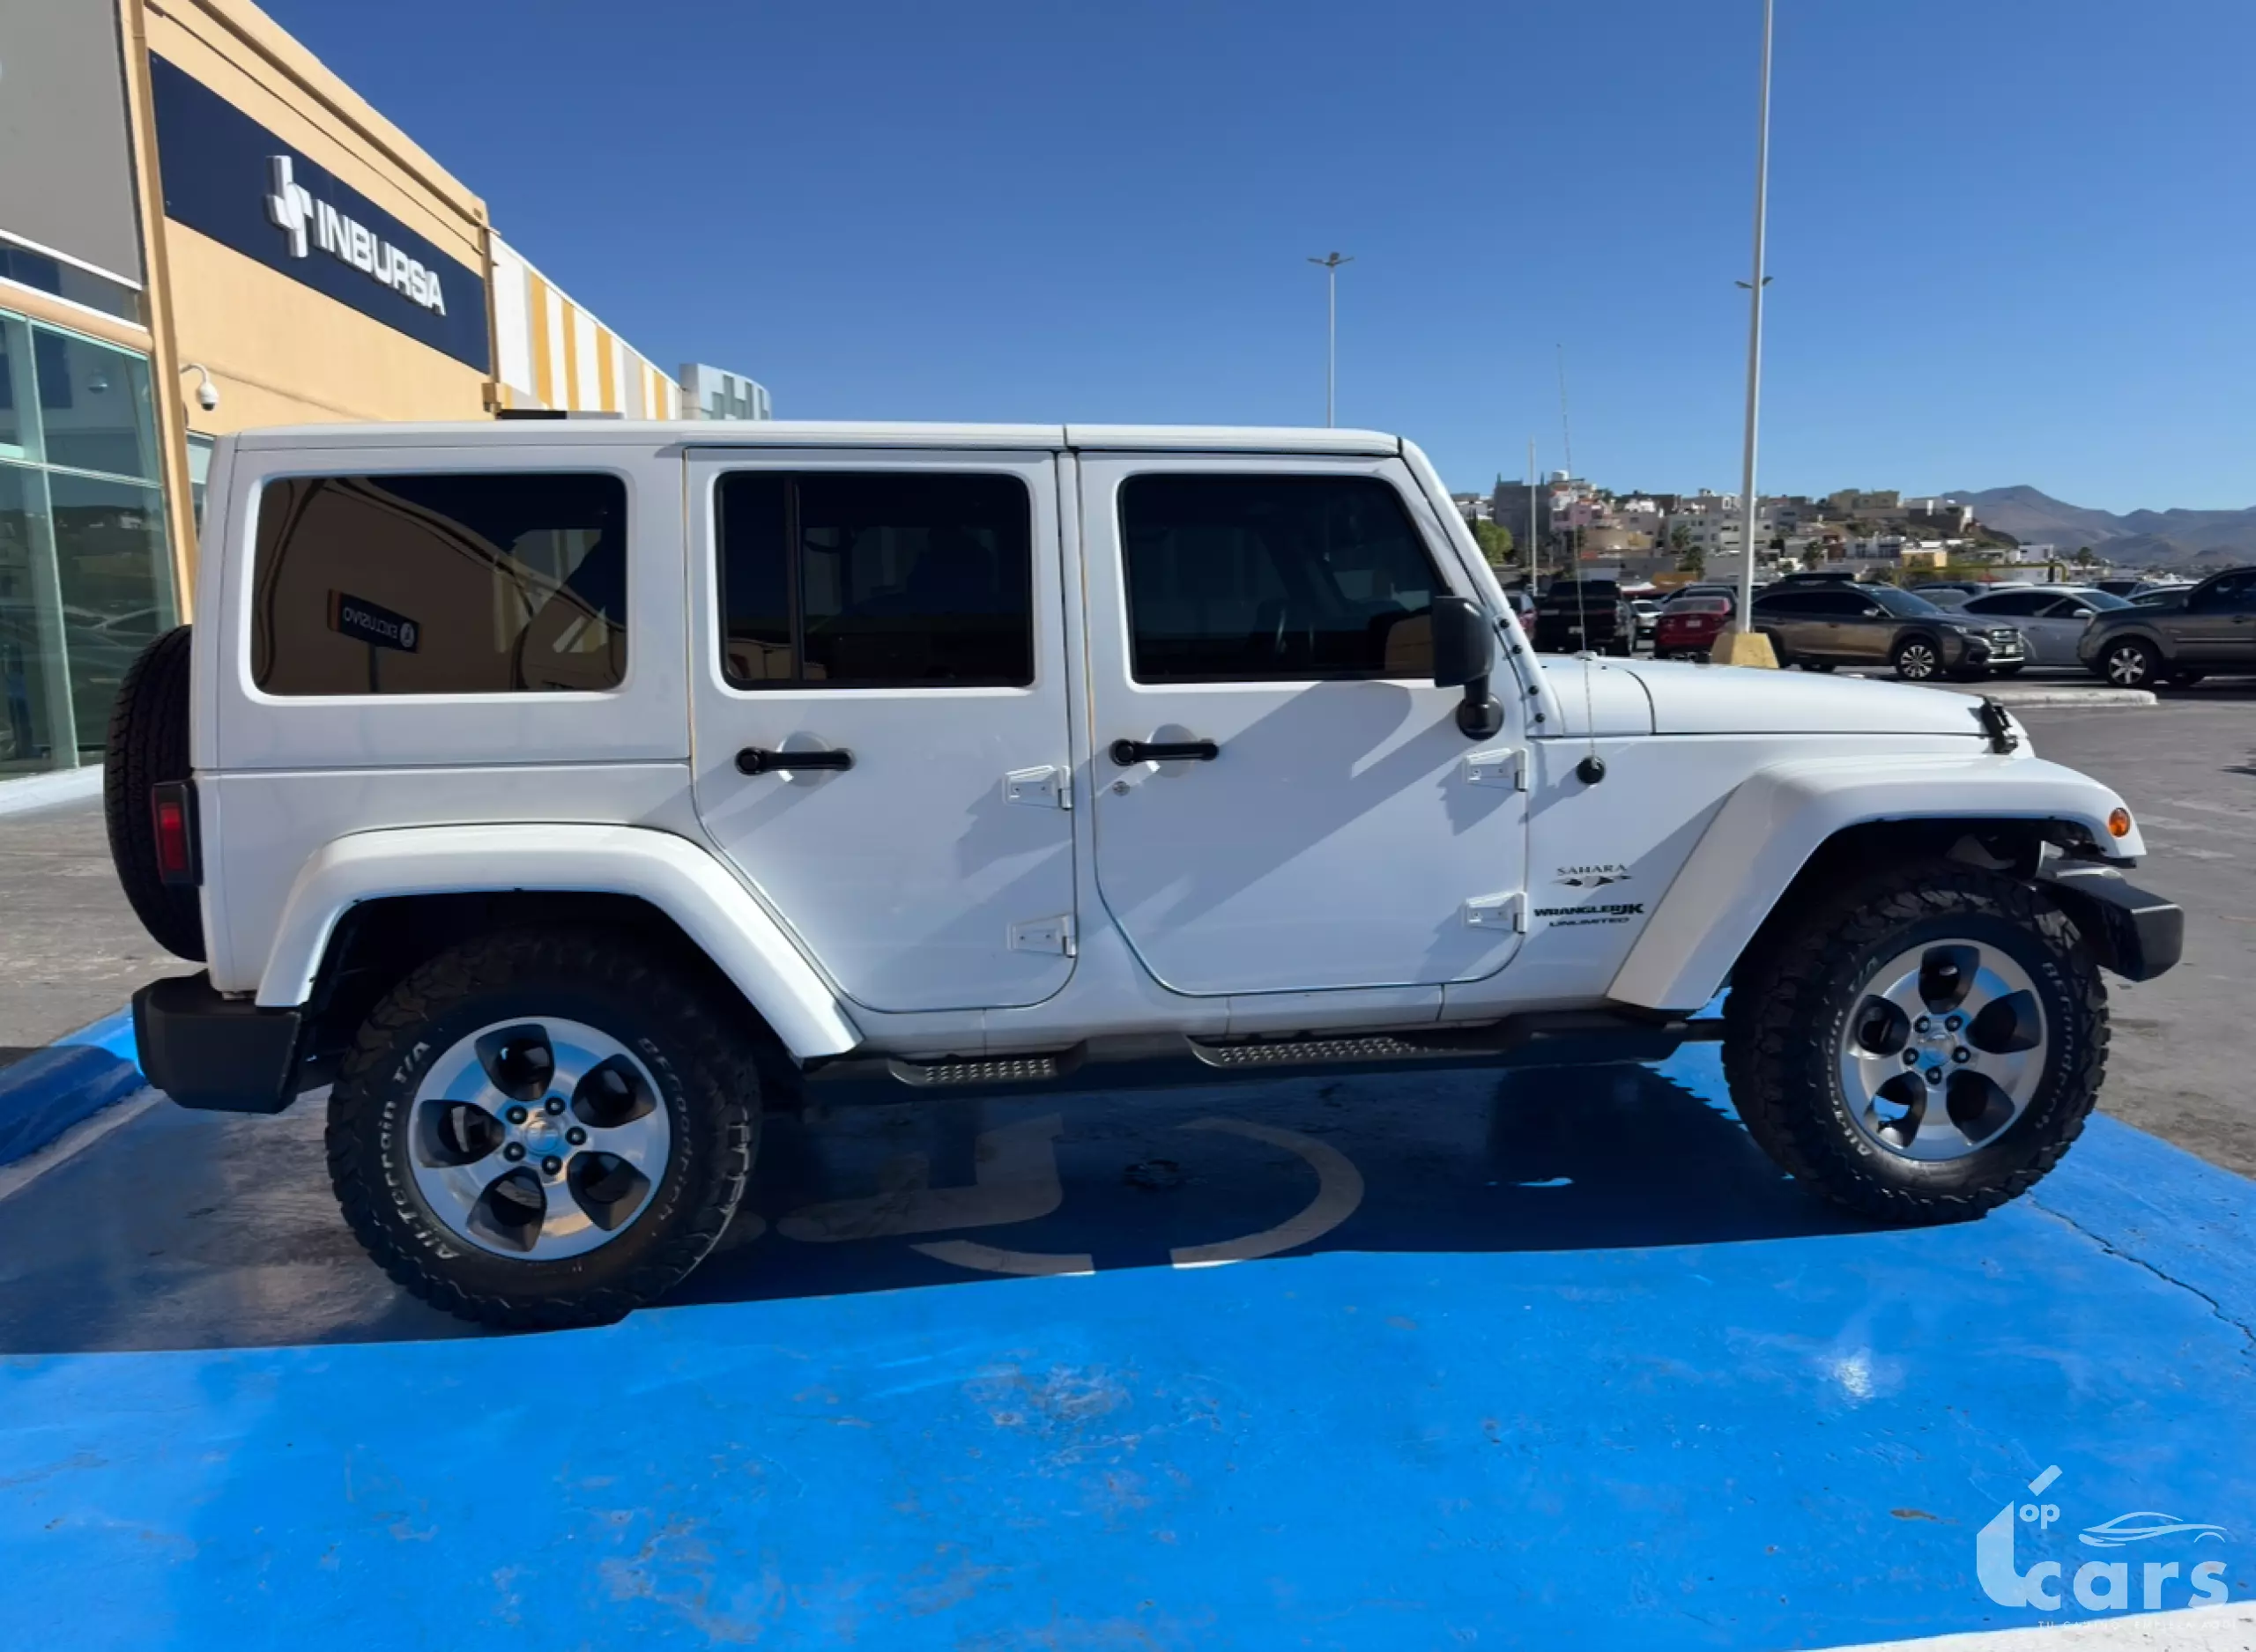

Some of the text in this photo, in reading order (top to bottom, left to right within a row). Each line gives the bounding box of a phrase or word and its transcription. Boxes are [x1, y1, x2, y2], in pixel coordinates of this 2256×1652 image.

[313, 199, 446, 315] INBURSA
[1557, 863, 1628, 876] SAHARA
[1549, 917, 1630, 927] UNLIMITED
